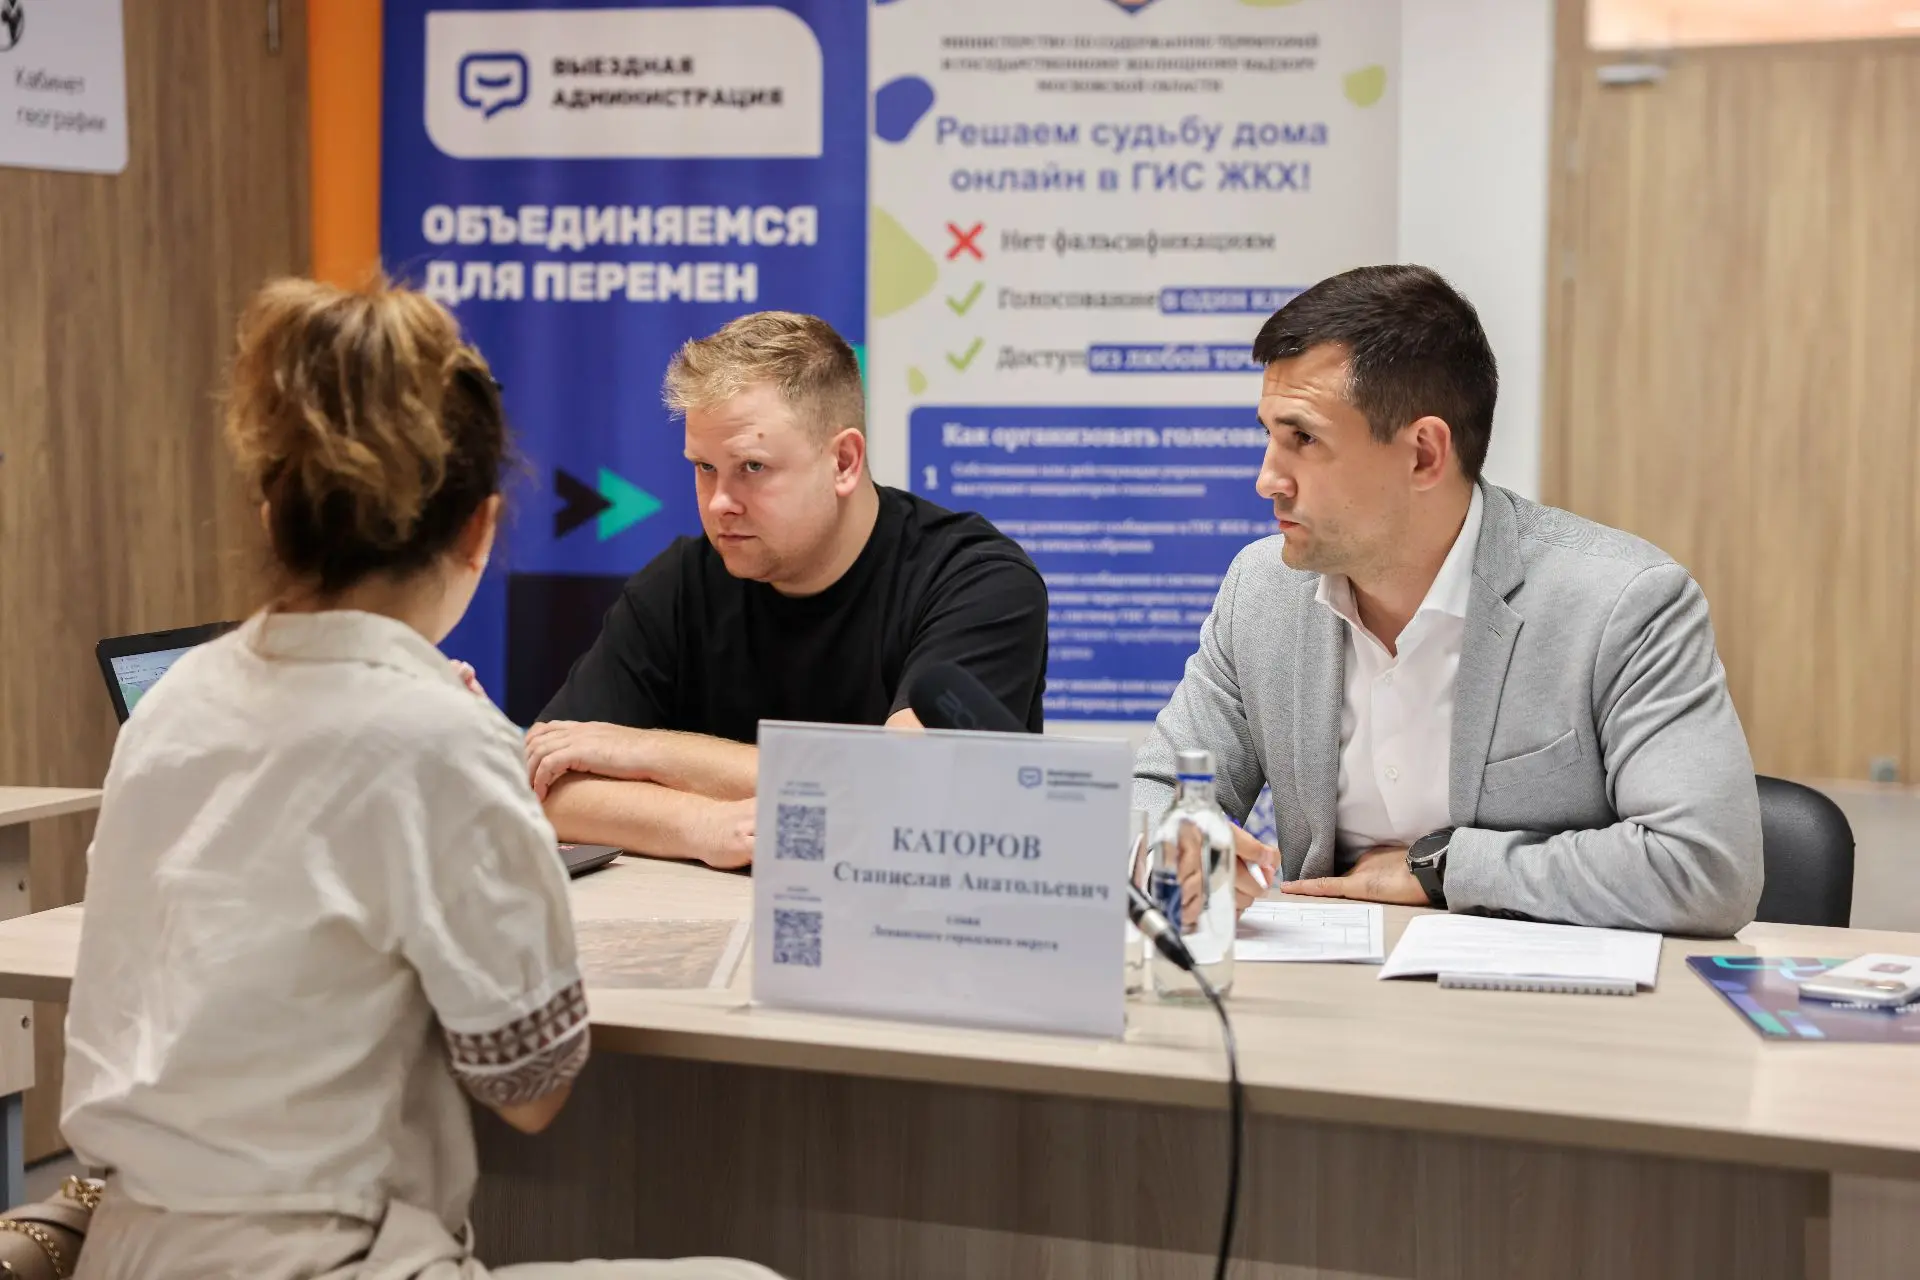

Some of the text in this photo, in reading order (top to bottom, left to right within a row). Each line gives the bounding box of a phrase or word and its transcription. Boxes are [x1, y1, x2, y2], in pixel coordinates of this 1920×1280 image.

[553, 57, 694, 76] ВЫЕЗДНАЯ
[552, 87, 784, 109] АДМИНИСТРАЦИЯ
[936, 115, 1329, 153] Решаем судьбу дома
[950, 162, 1312, 191] онлайн в ГИС ЖКХ!
[422, 205, 818, 251] ОБЪЕДИНЯЕМСЯ
[1001, 231, 1044, 250] Нет
[425, 261, 759, 307] ДЛЯ ПЕРЕМЕН
[1216, 350, 1256, 369] точ
[893, 826, 1042, 861] КАТОРОВ
[833, 861, 1110, 900] Станислав Анатольевич
